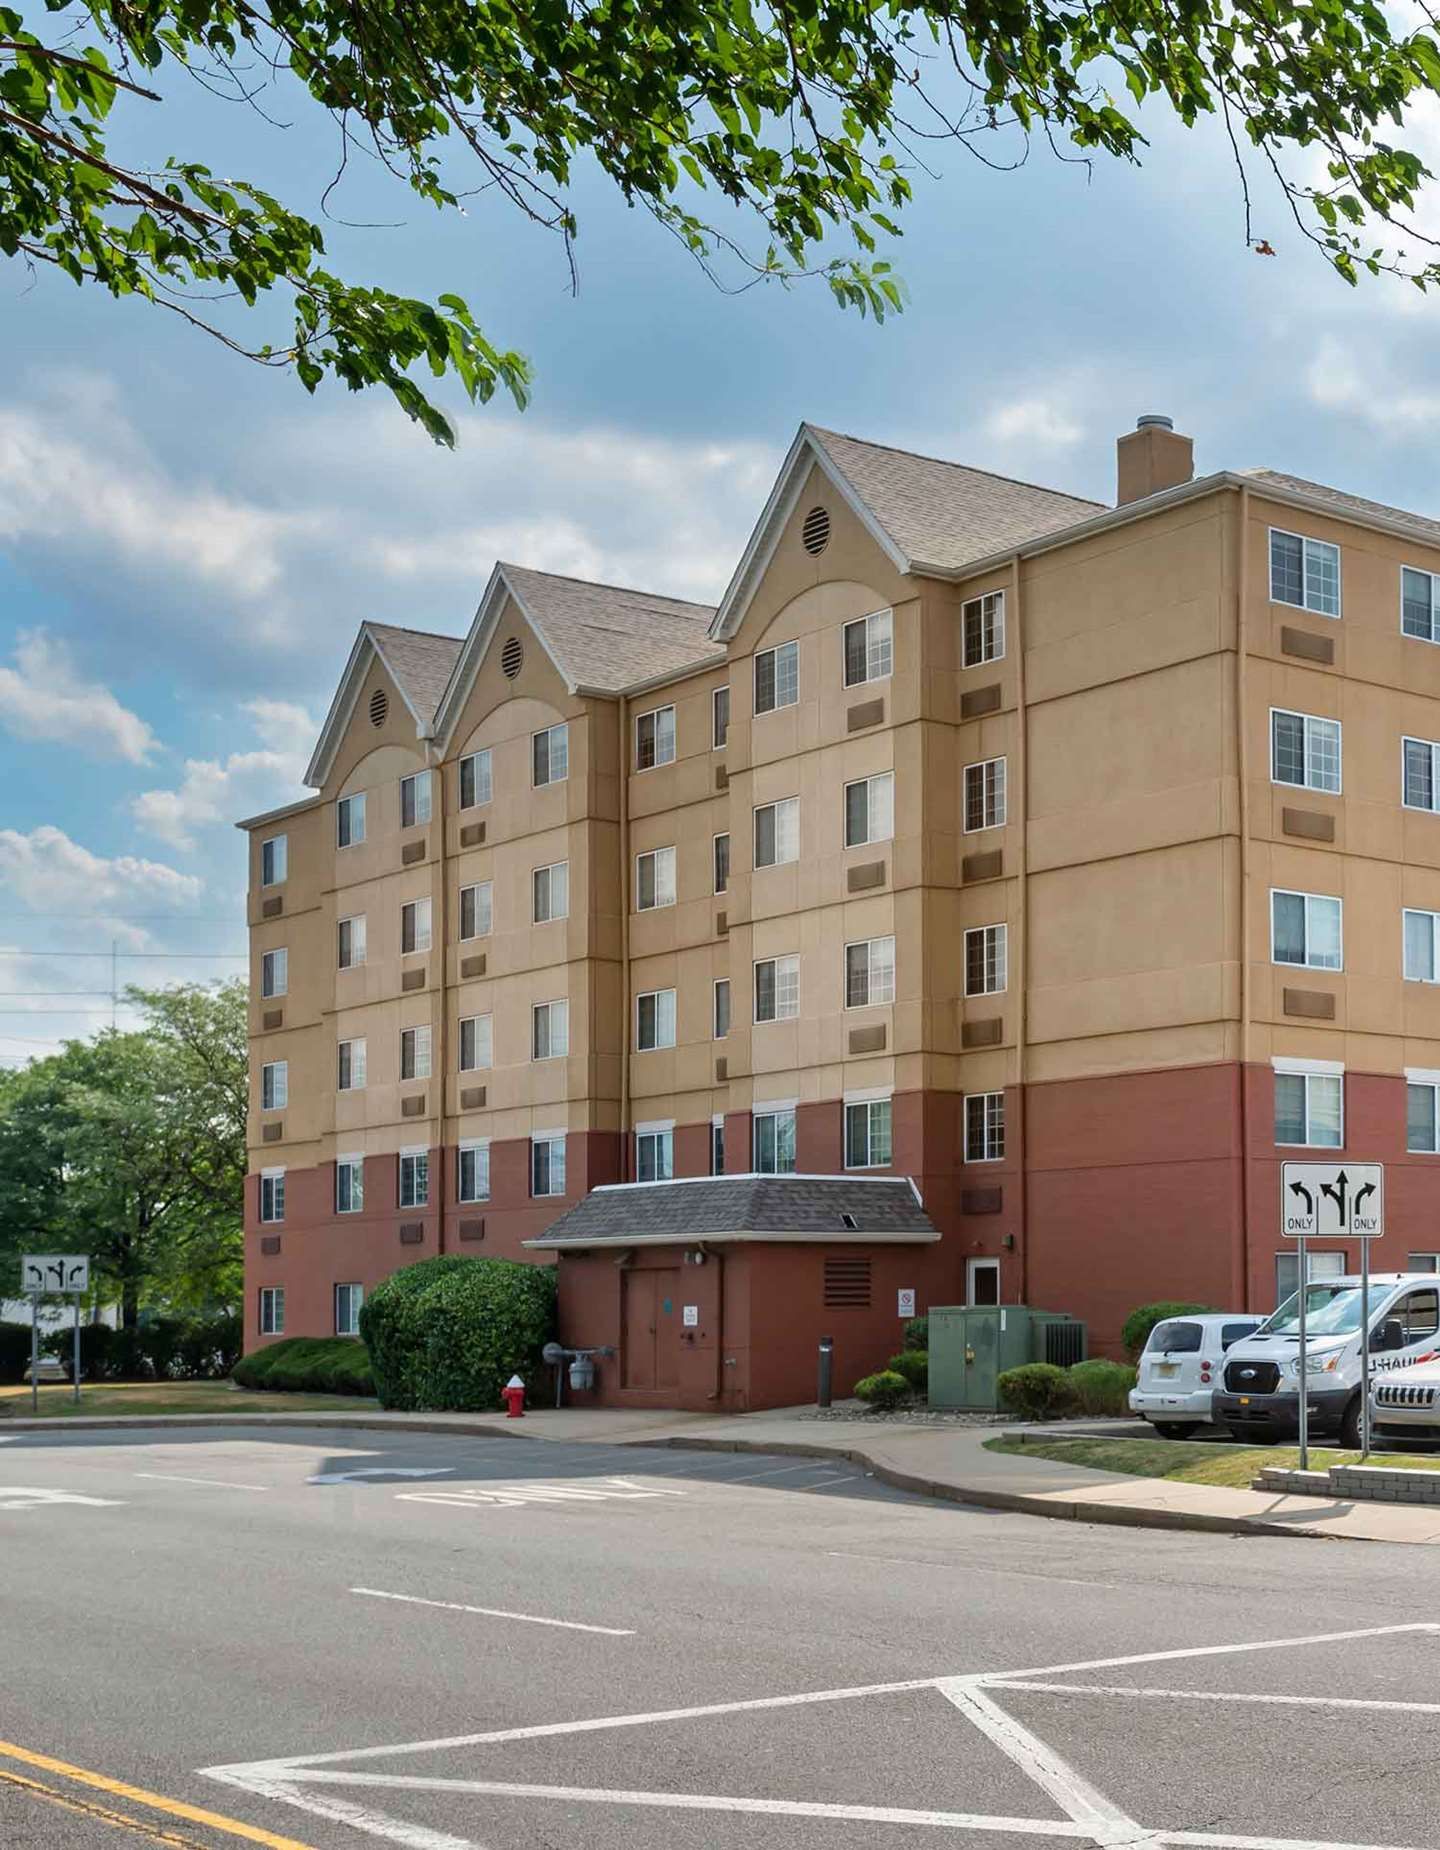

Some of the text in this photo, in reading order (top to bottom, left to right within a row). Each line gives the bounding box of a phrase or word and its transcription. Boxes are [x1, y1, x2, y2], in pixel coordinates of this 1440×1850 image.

[1288, 1218, 1312, 1230] ONLY
[1354, 1218, 1377, 1230] ONLY
[394, 1478, 688, 1507] ONLY
